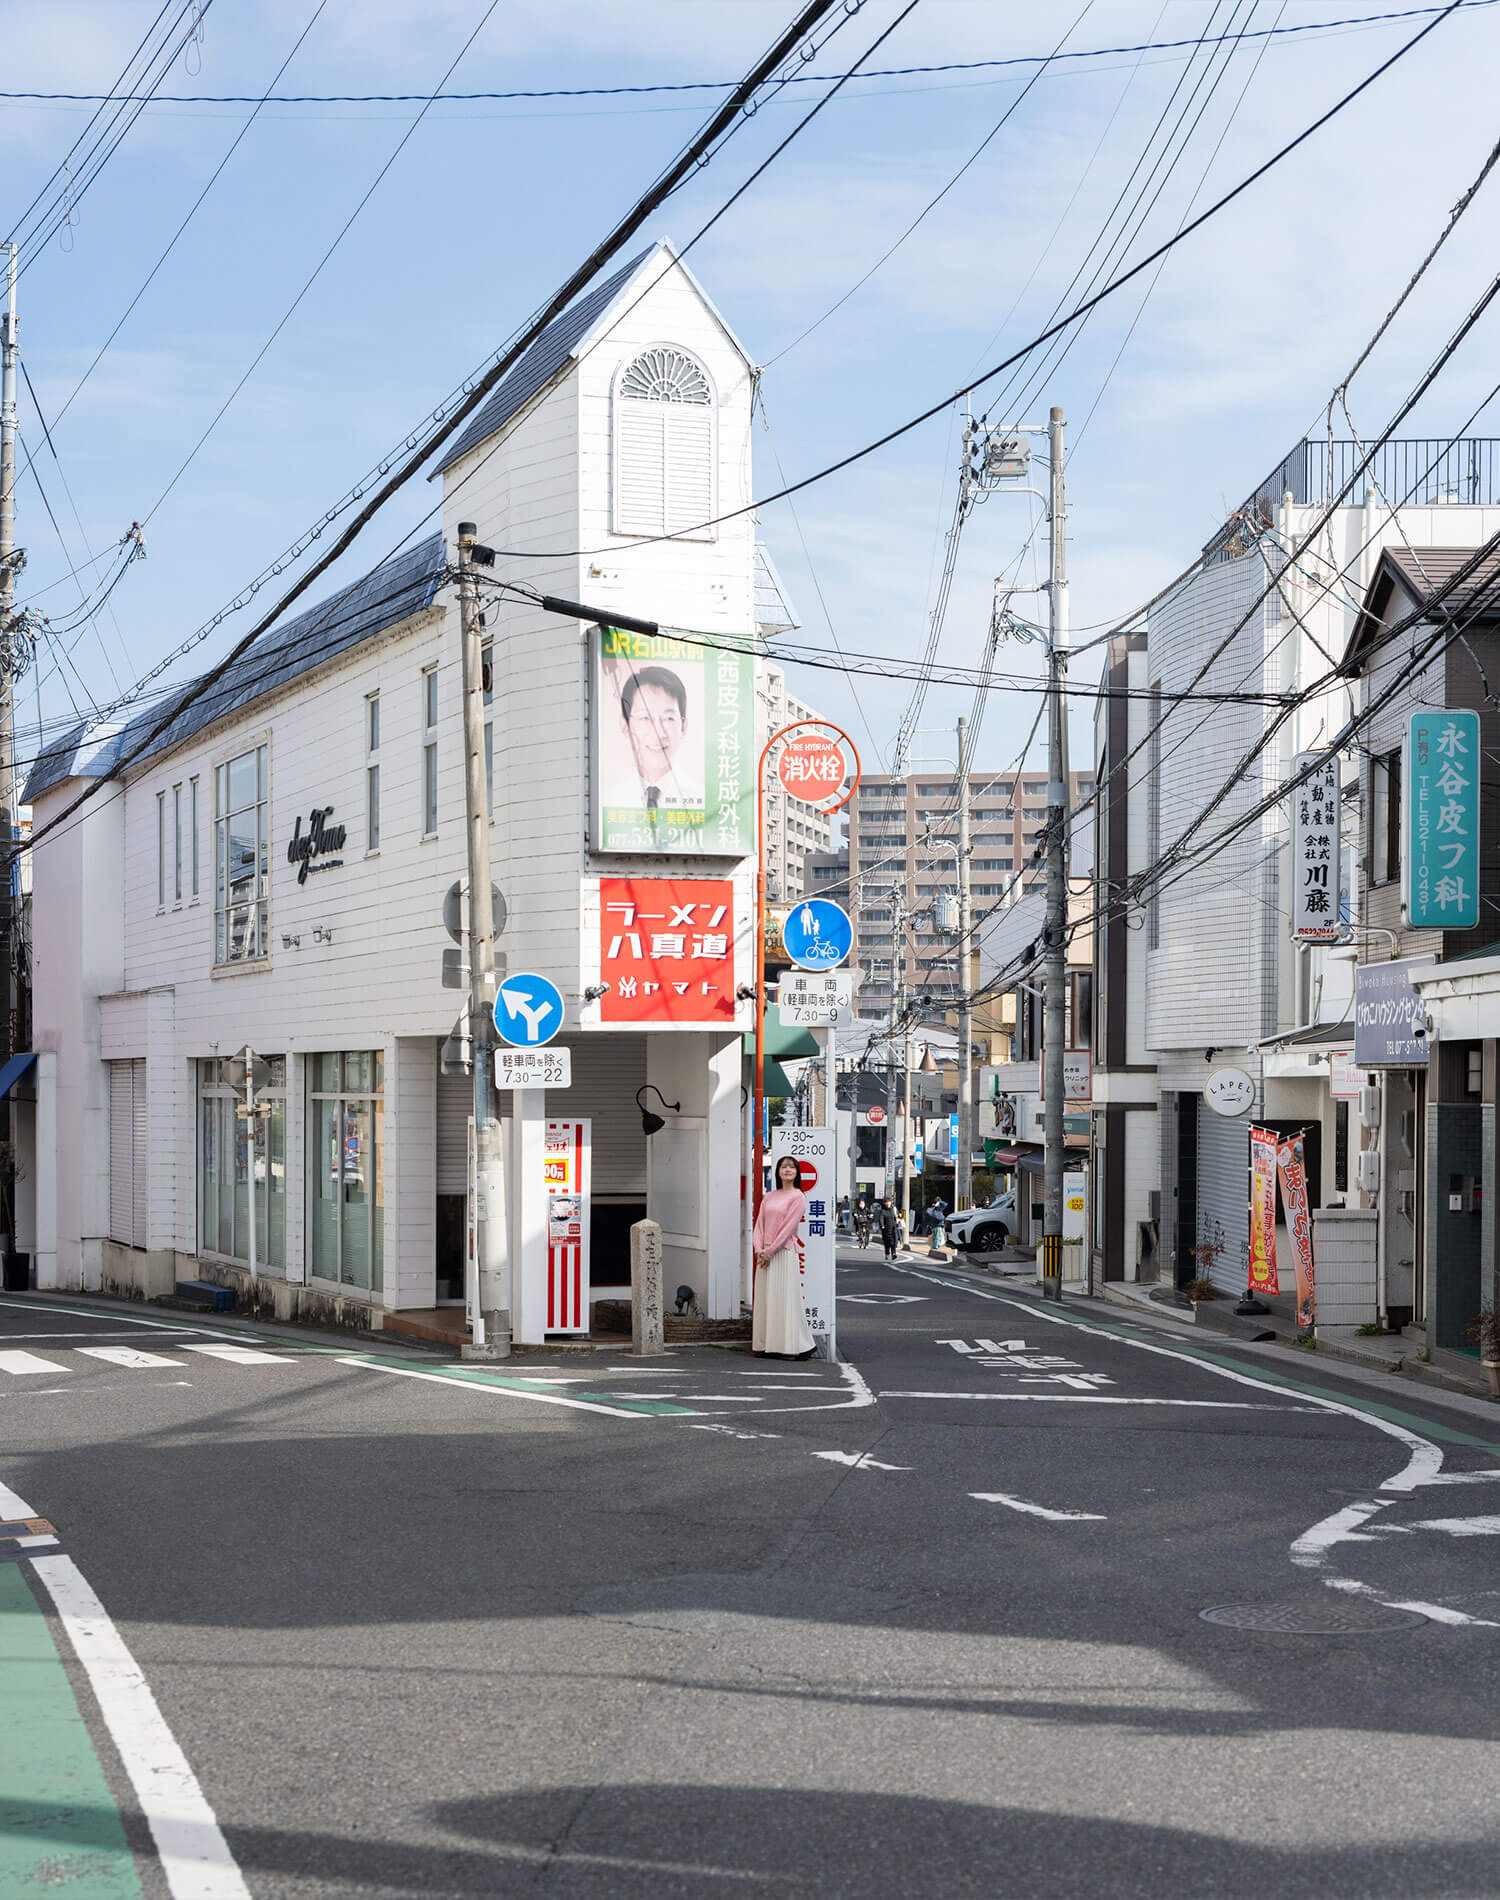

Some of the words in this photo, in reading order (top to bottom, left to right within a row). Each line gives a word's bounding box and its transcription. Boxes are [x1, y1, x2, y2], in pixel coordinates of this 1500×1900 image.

[789, 743, 803, 751] FIRE
[804, 743, 834, 751] HYDRANT
[1417, 728, 1429, 765] P有り
[784, 755, 840, 781] 消火栓
[1434, 722, 1471, 912] 永谷皮フ科
[1304, 864, 1331, 913] 川藤
[606, 902, 727, 927] ラーメン
[1323, 919, 1334, 927] 2F
[607, 933, 728, 959] 八真道
[642, 982, 719, 995] ヤマト
[502, 1053, 563, 1068] 軽車両を除く
[1209, 1081, 1251, 1095] LAPEL
[791, 1144, 826, 1155] 22:00
[808, 1199, 827, 1238] 車両
